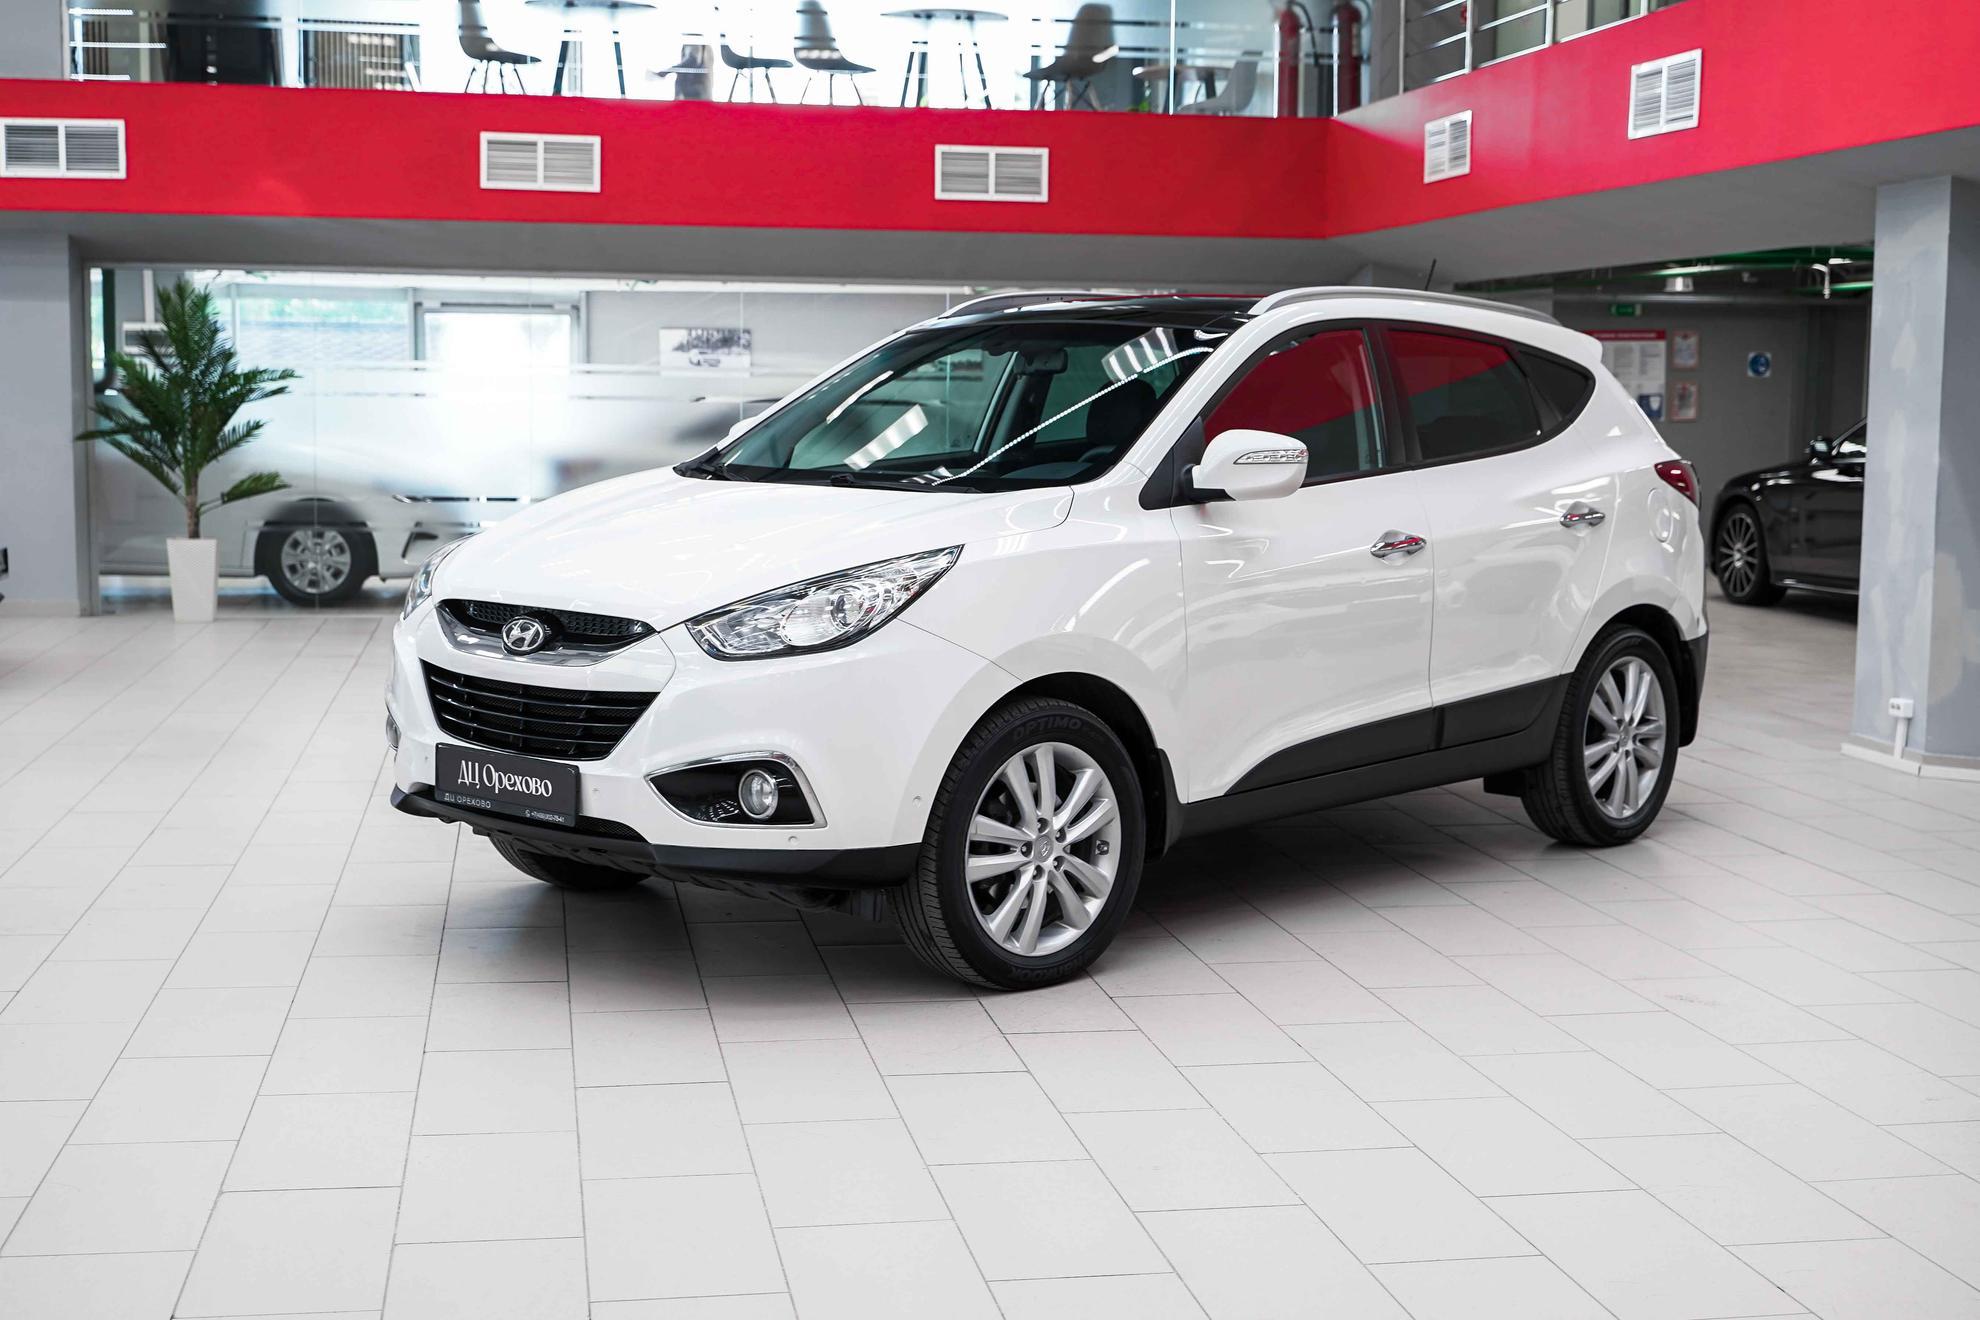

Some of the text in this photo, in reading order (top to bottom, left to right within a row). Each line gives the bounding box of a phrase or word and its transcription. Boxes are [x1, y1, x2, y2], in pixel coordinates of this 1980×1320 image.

[1013, 716, 1083, 739] OPTIMO
[457, 760, 553, 797] ДЦ Орехово
[457, 795, 491, 808] ОРЕХОВО
